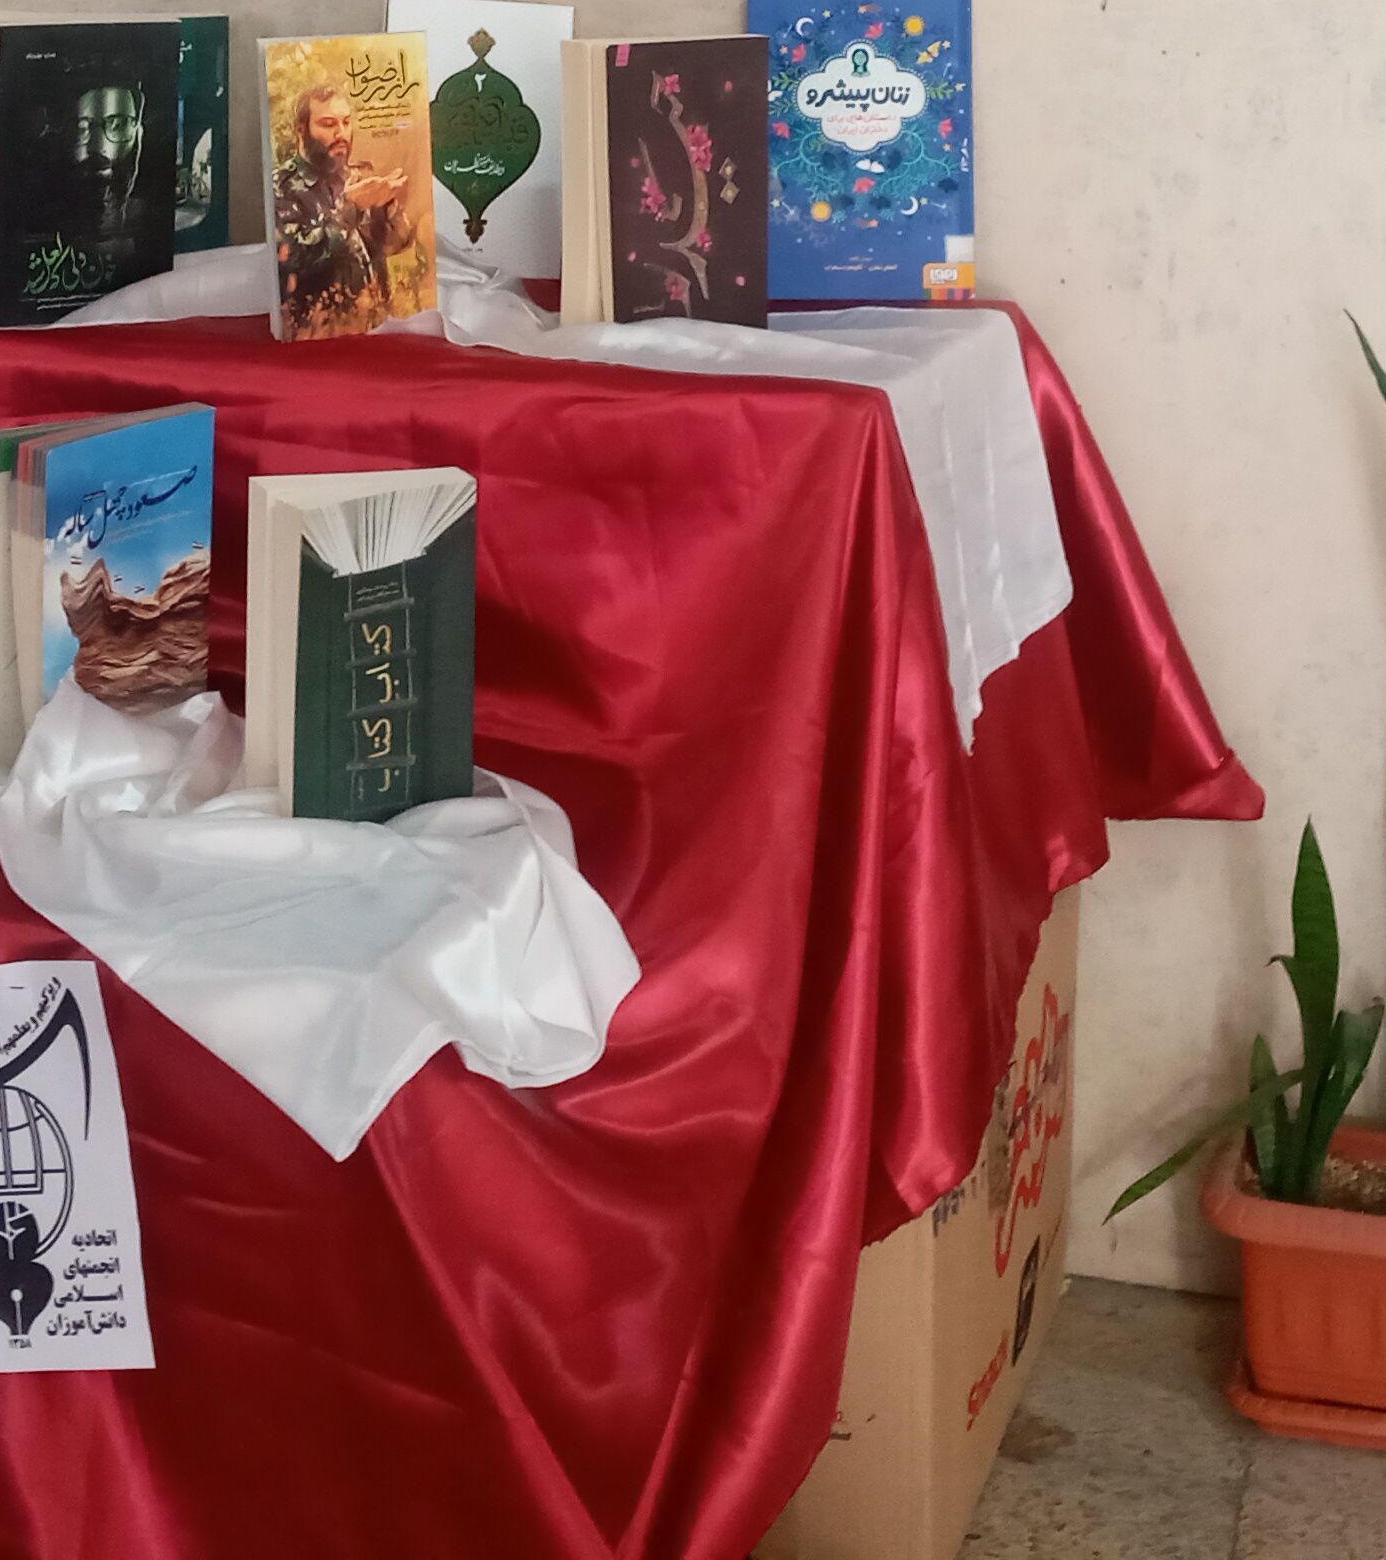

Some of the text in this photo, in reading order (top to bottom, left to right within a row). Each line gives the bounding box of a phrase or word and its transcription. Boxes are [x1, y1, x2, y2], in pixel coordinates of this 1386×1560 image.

[805, 78, 912, 113] زنان پیشرو
[71, 1229, 117, 1252] اتحادیه
[54, 1284, 124, 1308] اسلامی
